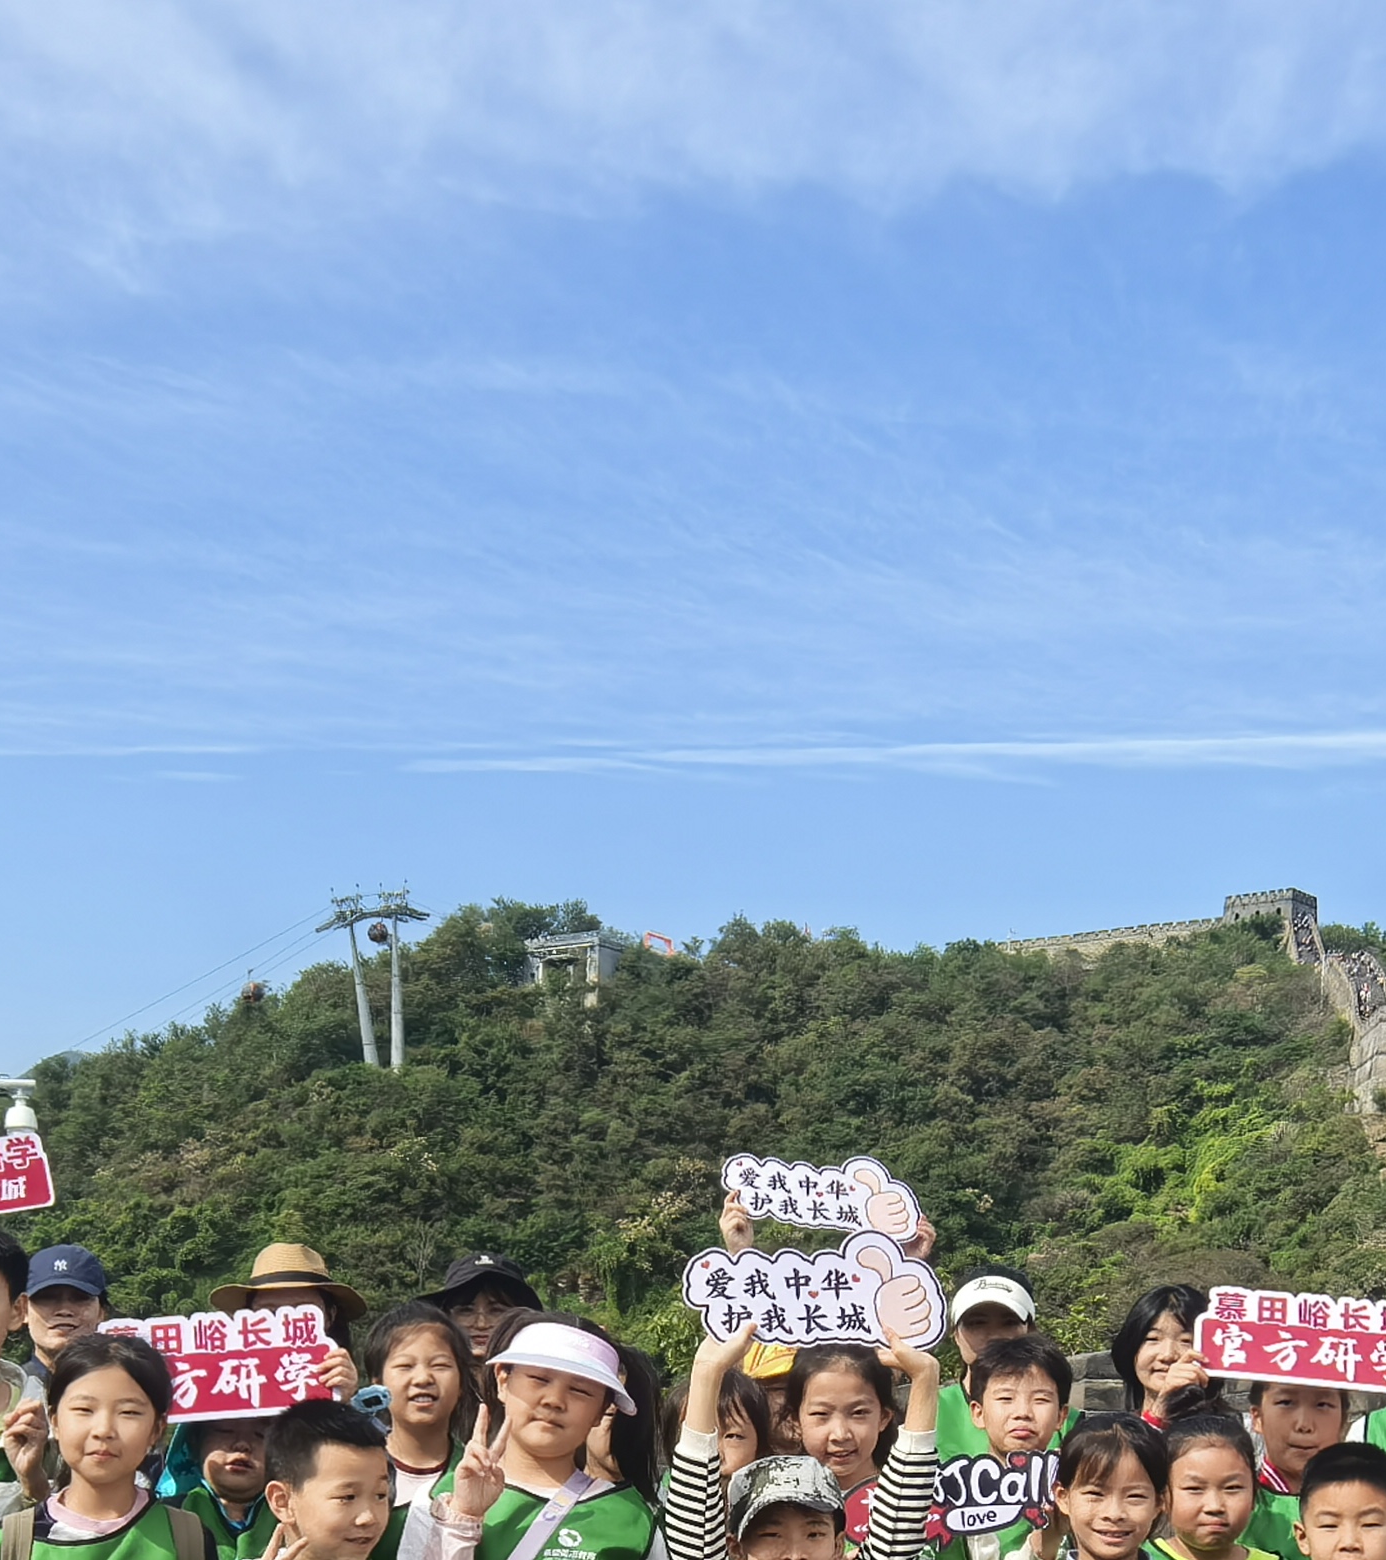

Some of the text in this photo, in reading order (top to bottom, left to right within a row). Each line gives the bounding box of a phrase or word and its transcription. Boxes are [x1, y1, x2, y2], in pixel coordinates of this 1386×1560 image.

[739, 1168, 849, 1200] 爱我中华
[749, 1192, 863, 1227] 护我长城
[705, 1268, 853, 1300] 爱我中华
[721, 1303, 871, 1335] 护我长城
[173, 1352, 319, 1409] 方研学
[961, 1510, 998, 1529] love
